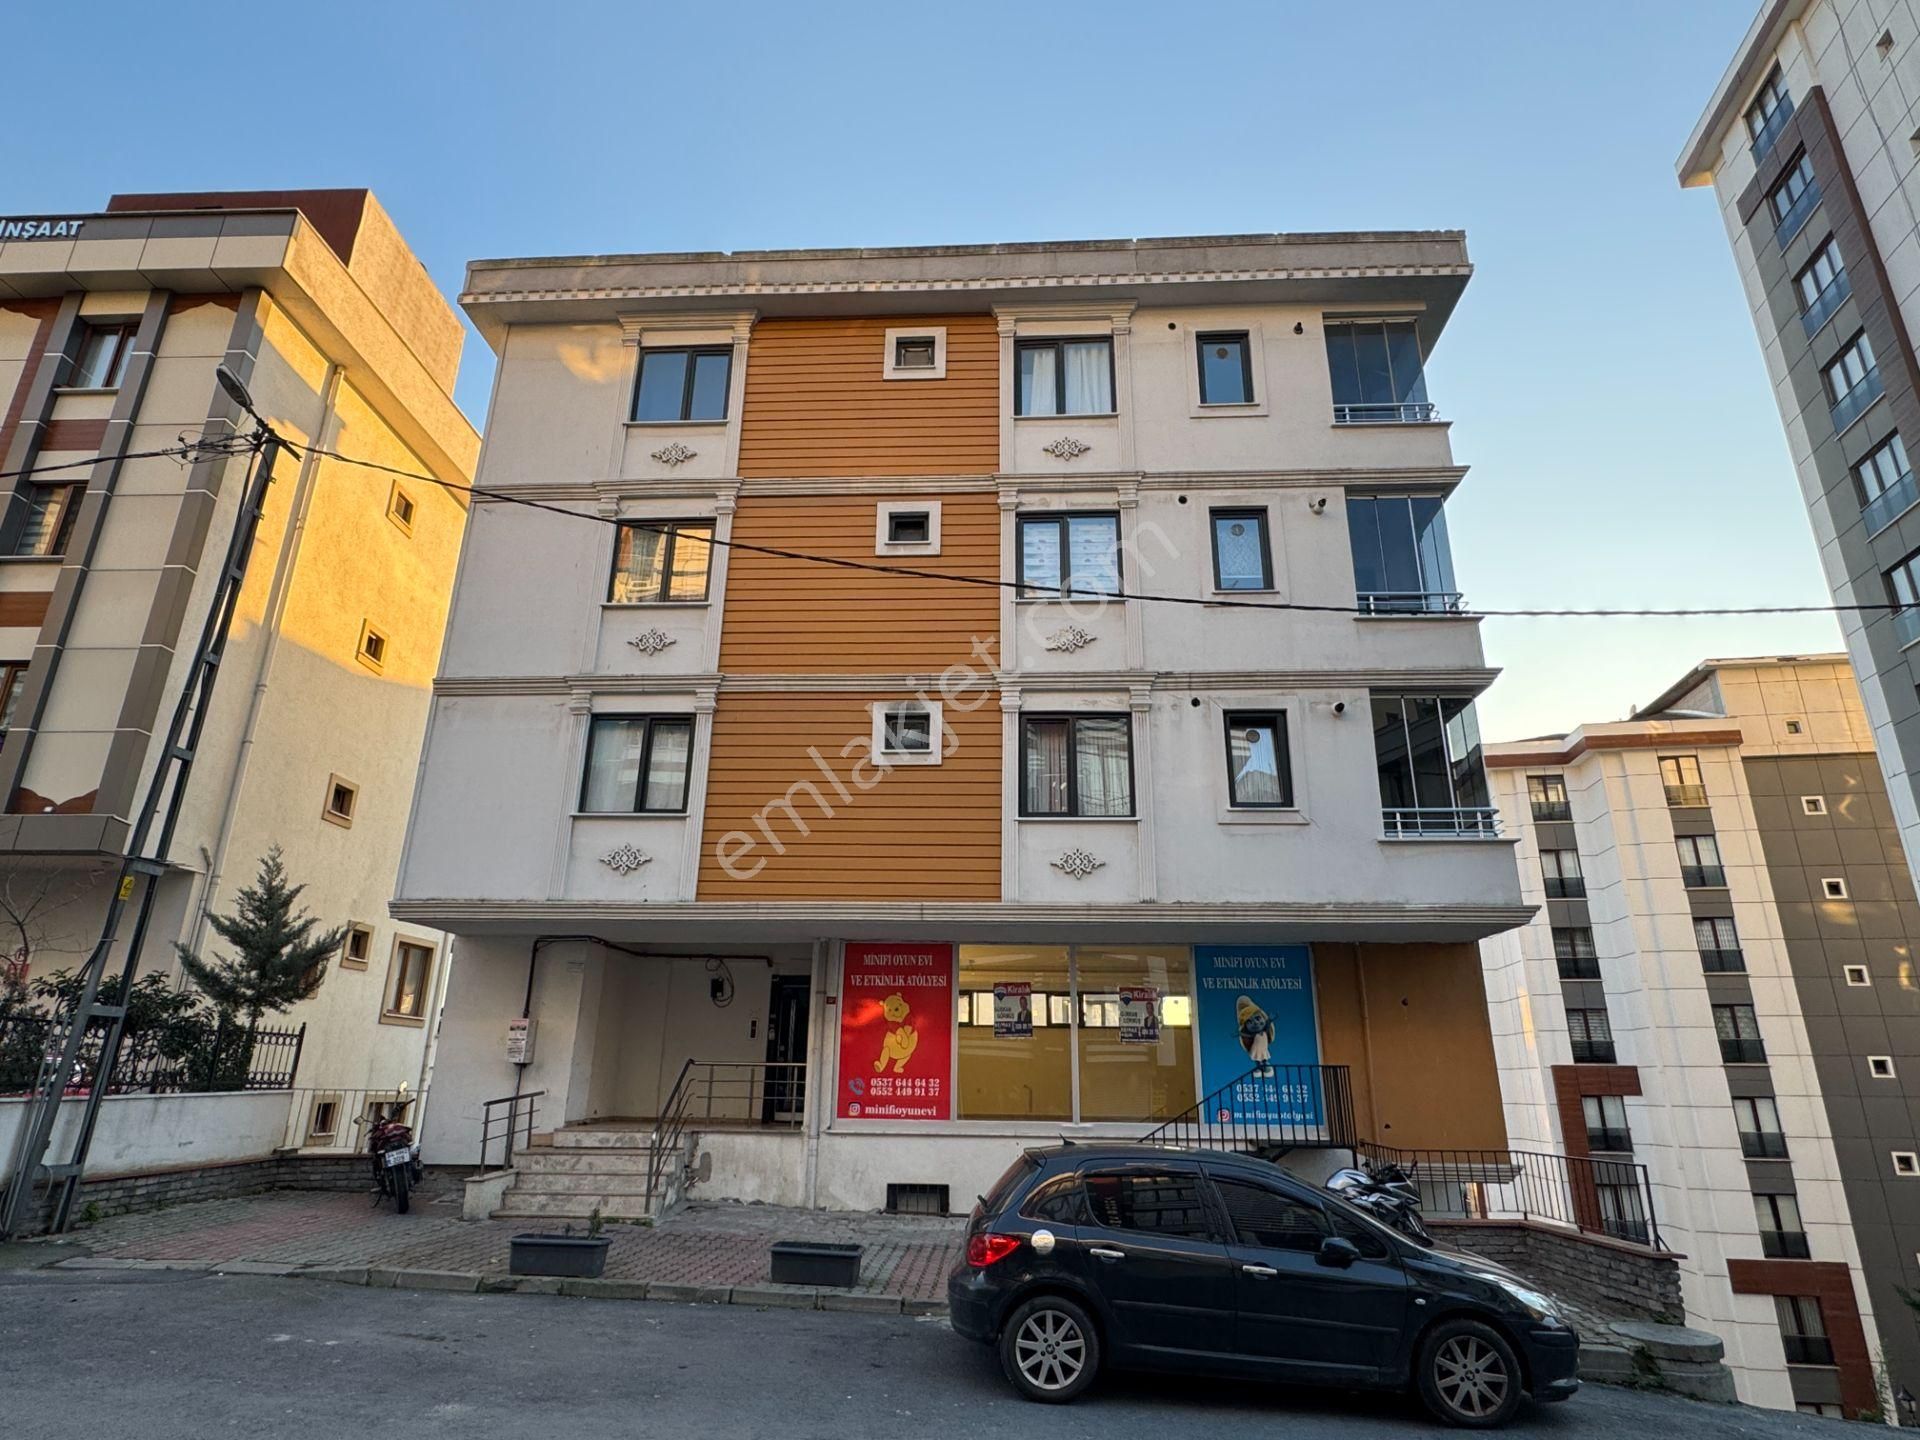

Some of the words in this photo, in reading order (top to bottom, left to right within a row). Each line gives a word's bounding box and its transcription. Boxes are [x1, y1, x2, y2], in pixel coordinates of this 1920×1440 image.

[0, 219, 83, 239] İNŞAAT
[893, 954, 916, 967] OYUN
[1244, 957, 1269, 969] OYUN
[851, 974, 862, 986] VE
[1202, 977, 1215, 989] VE
[870, 1078, 893, 1087] 0537
[895, 1078, 912, 1088] 644
[914, 1079, 927, 1088] 64
[928, 1079, 940, 1088] 32
[870, 1087, 893, 1096] 0552
[895, 1087, 912, 1096] 449
[914, 1088, 927, 1097] 91
[928, 1088, 940, 1097] 37
[865, 1104, 937, 1118] minifioyunevi
